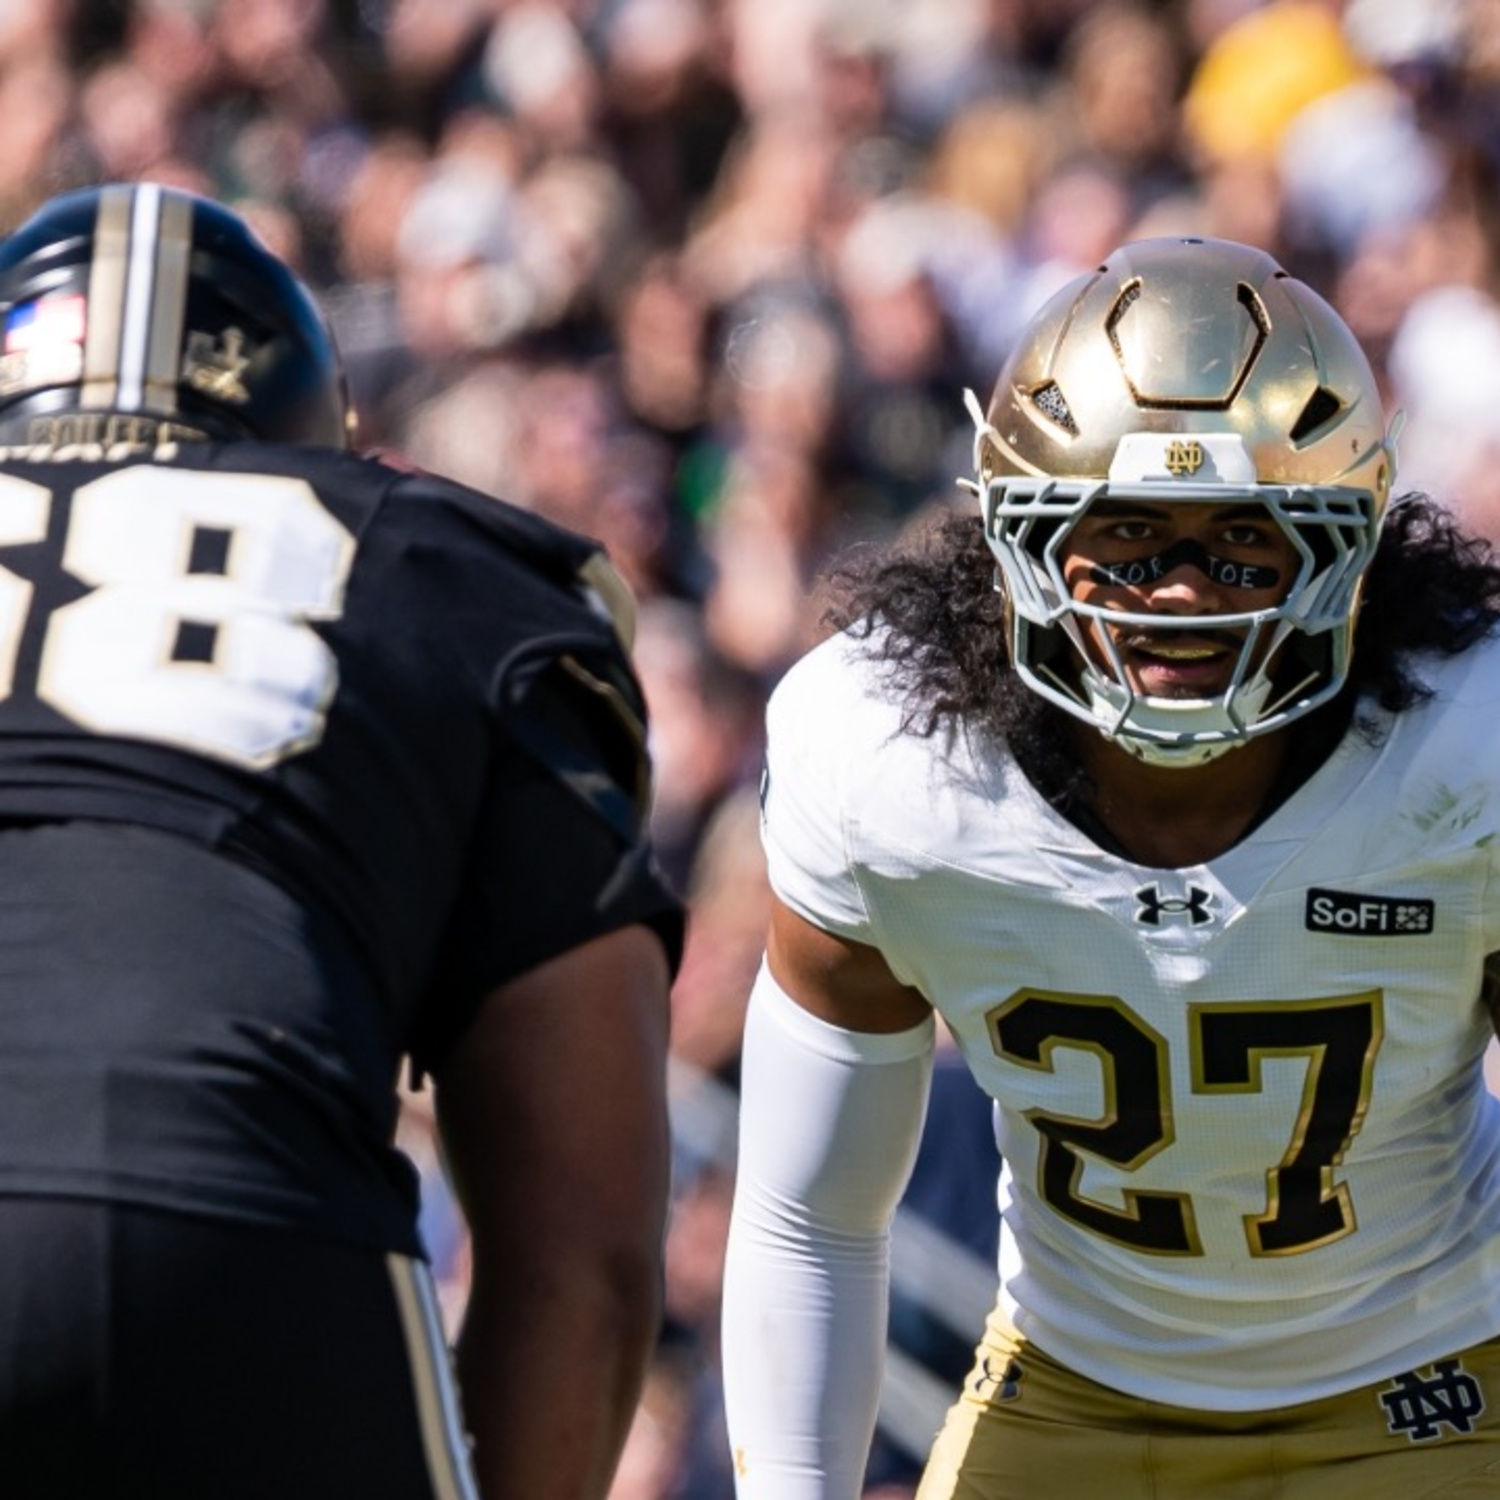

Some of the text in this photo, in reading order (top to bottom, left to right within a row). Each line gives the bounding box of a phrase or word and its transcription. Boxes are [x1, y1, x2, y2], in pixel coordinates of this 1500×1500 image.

[0, 463, 358, 773] 8
[1109, 555, 1258, 588] FOR TOE
[1312, 897, 1388, 930] SoFi
[985, 987, 1384, 1258] 27
